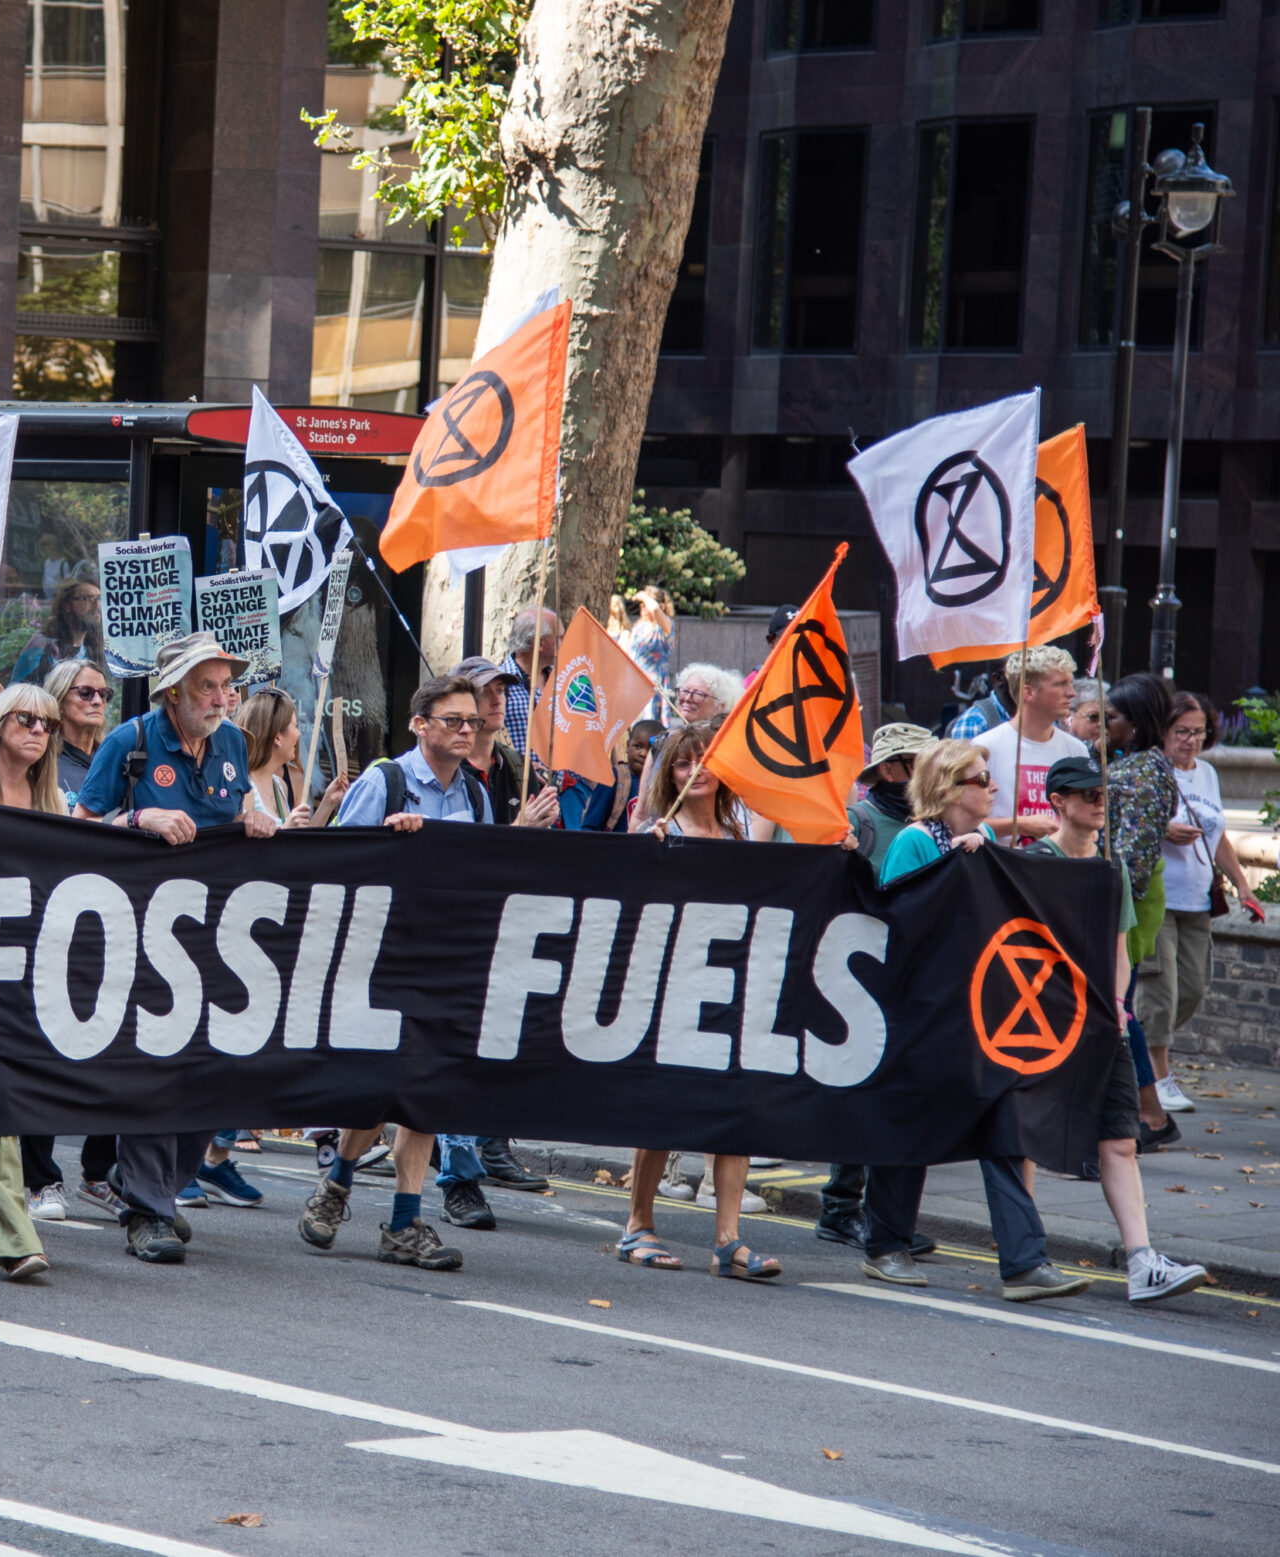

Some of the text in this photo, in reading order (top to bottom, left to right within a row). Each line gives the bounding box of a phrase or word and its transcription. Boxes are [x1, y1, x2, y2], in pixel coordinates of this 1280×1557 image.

[296, 416, 371, 431] St James's Park
[309, 431, 344, 444] Station
[115, 541, 177, 555] Socialist Worker
[104, 554, 176, 576] SYSTEM
[105, 569, 180, 592] CHANGE
[209, 573, 263, 587] Socialist Worker
[106, 590, 144, 607] NOT
[200, 584, 263, 605] SYSTEM
[106, 601, 183, 622] CLIMATE
[201, 597, 267, 618] CHANGE
[107, 616, 181, 638] CHANGE
[202, 615, 234, 631] NOT
[214, 622, 270, 643] LIMATE
[222, 636, 269, 654] ANGE
[1026, 771, 1048, 785] THE
[1028, 788, 1049, 804] IS N
[477, 893, 890, 1088] FUELS
